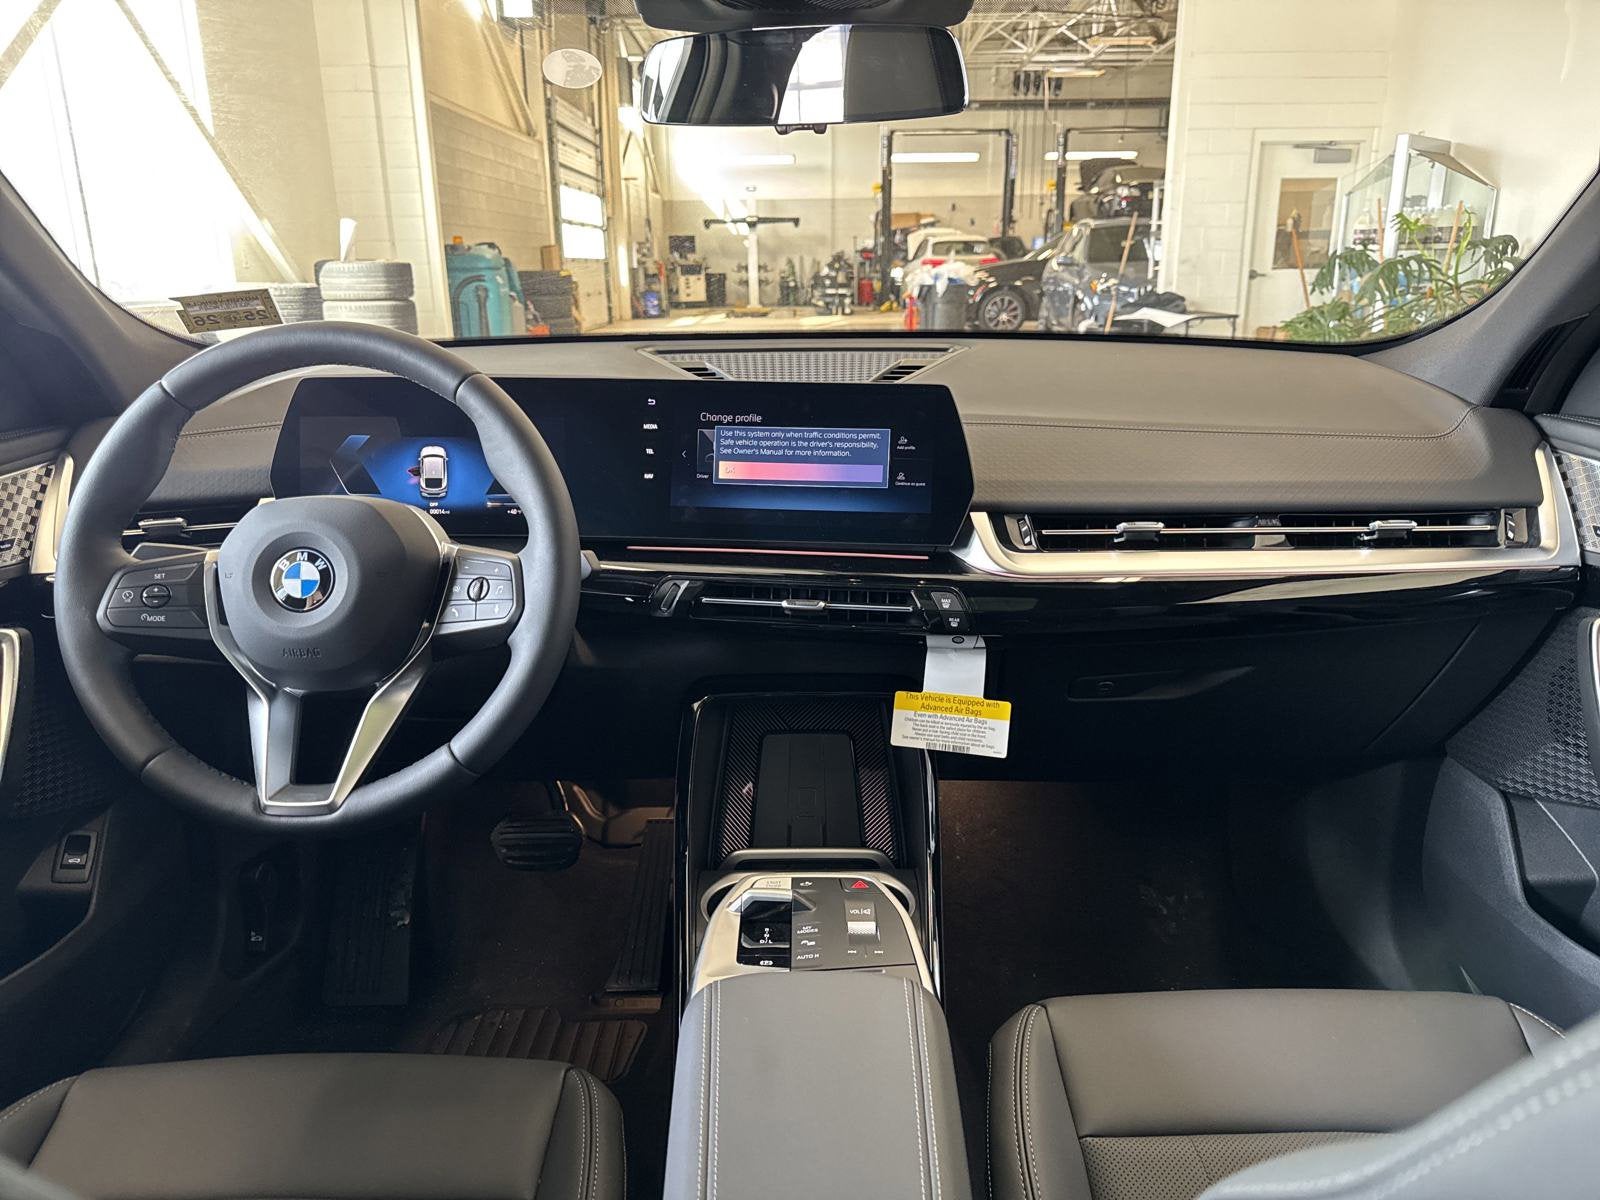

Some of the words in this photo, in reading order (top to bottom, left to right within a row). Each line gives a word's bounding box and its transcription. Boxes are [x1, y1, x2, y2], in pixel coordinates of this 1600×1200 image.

[700, 412, 732, 423] Change
[735, 414, 762, 424] profile
[278, 551, 328, 571] BMW
[282, 648, 322, 659] AIRBAG
[920, 694, 944, 703] Vehicle
[952, 697, 984, 708] Equipped
[920, 702, 952, 712] Advanced
[965, 707, 981, 717] Bags
[939, 714, 964, 722] Advanced
